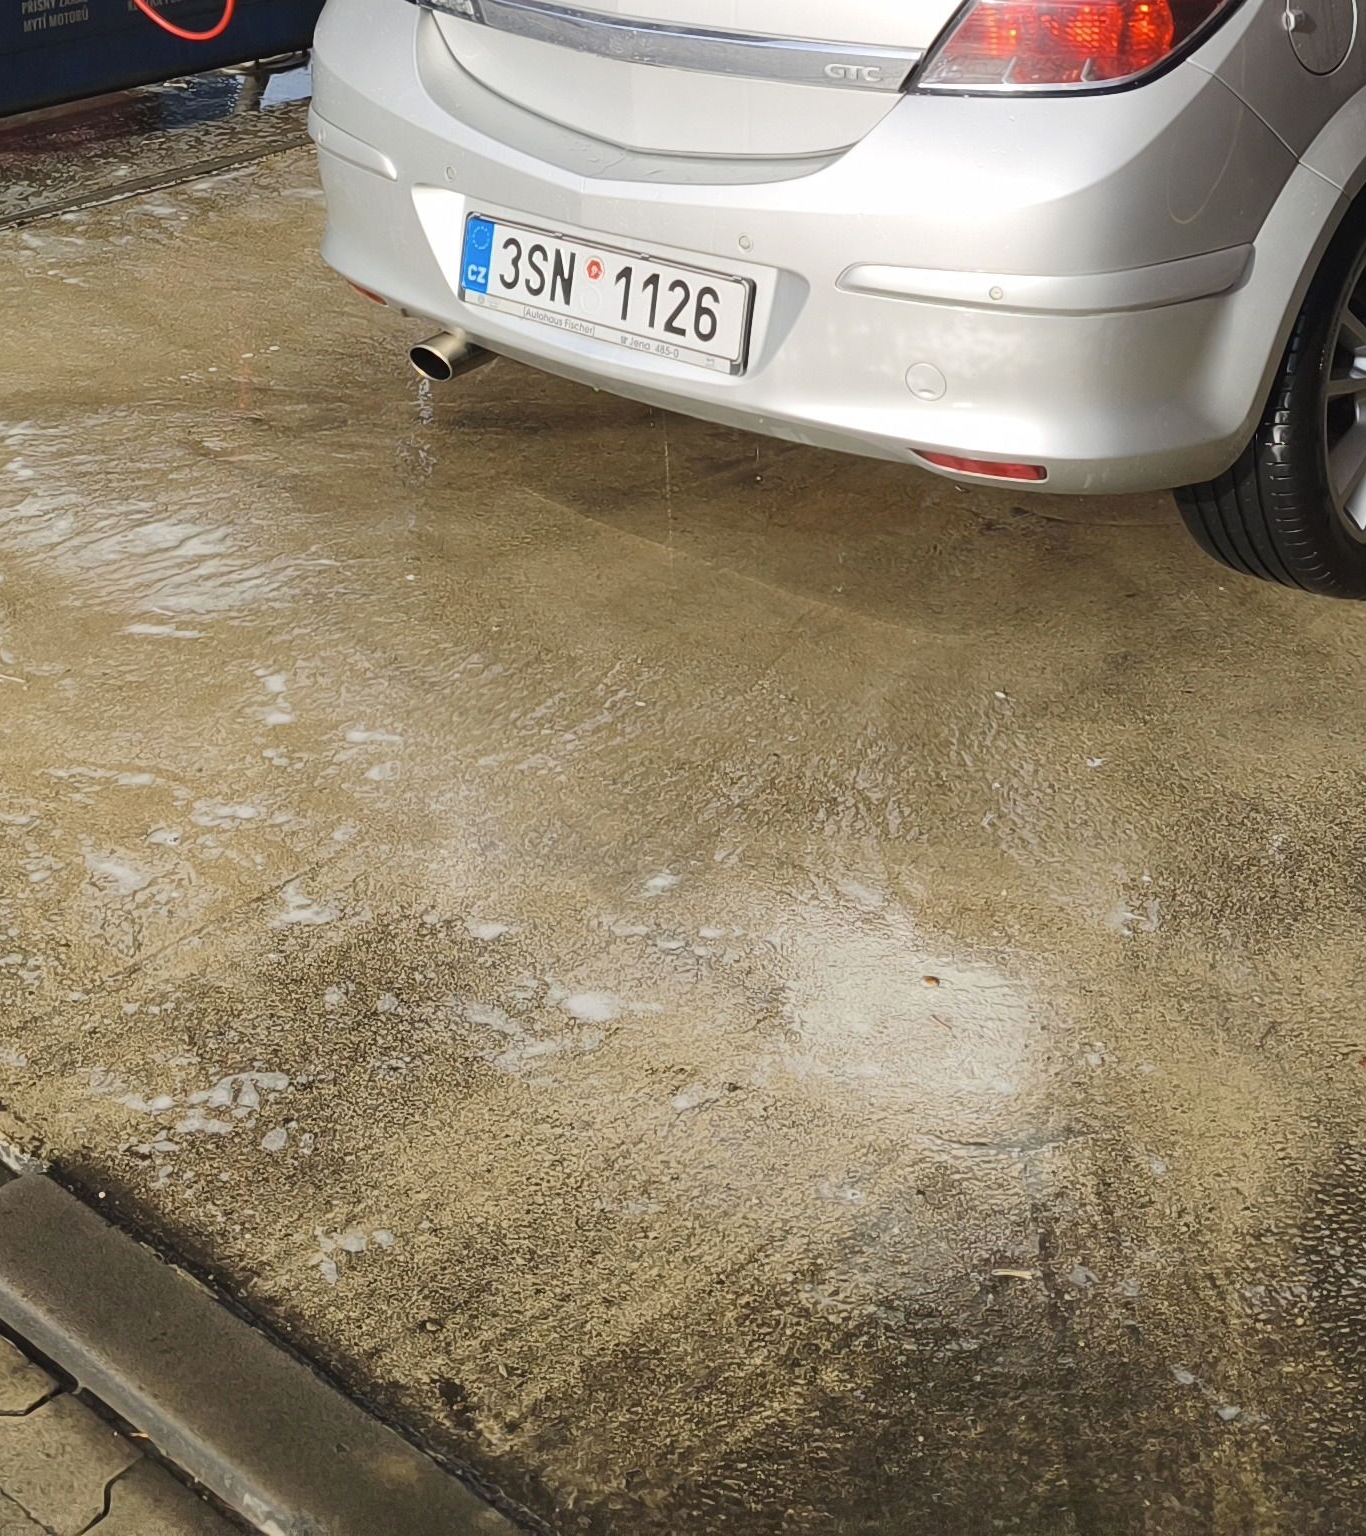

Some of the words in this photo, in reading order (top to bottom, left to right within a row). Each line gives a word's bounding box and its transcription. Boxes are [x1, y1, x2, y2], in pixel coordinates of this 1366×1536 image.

[23, 15, 47, 33] MYTÍ
[49, 8, 89, 28] MOTORŮ
[824, 63, 882, 82] GTC
[467, 264, 487, 284] CZ
[498, 237, 576, 306] 3SN
[614, 265, 720, 342] 1126
